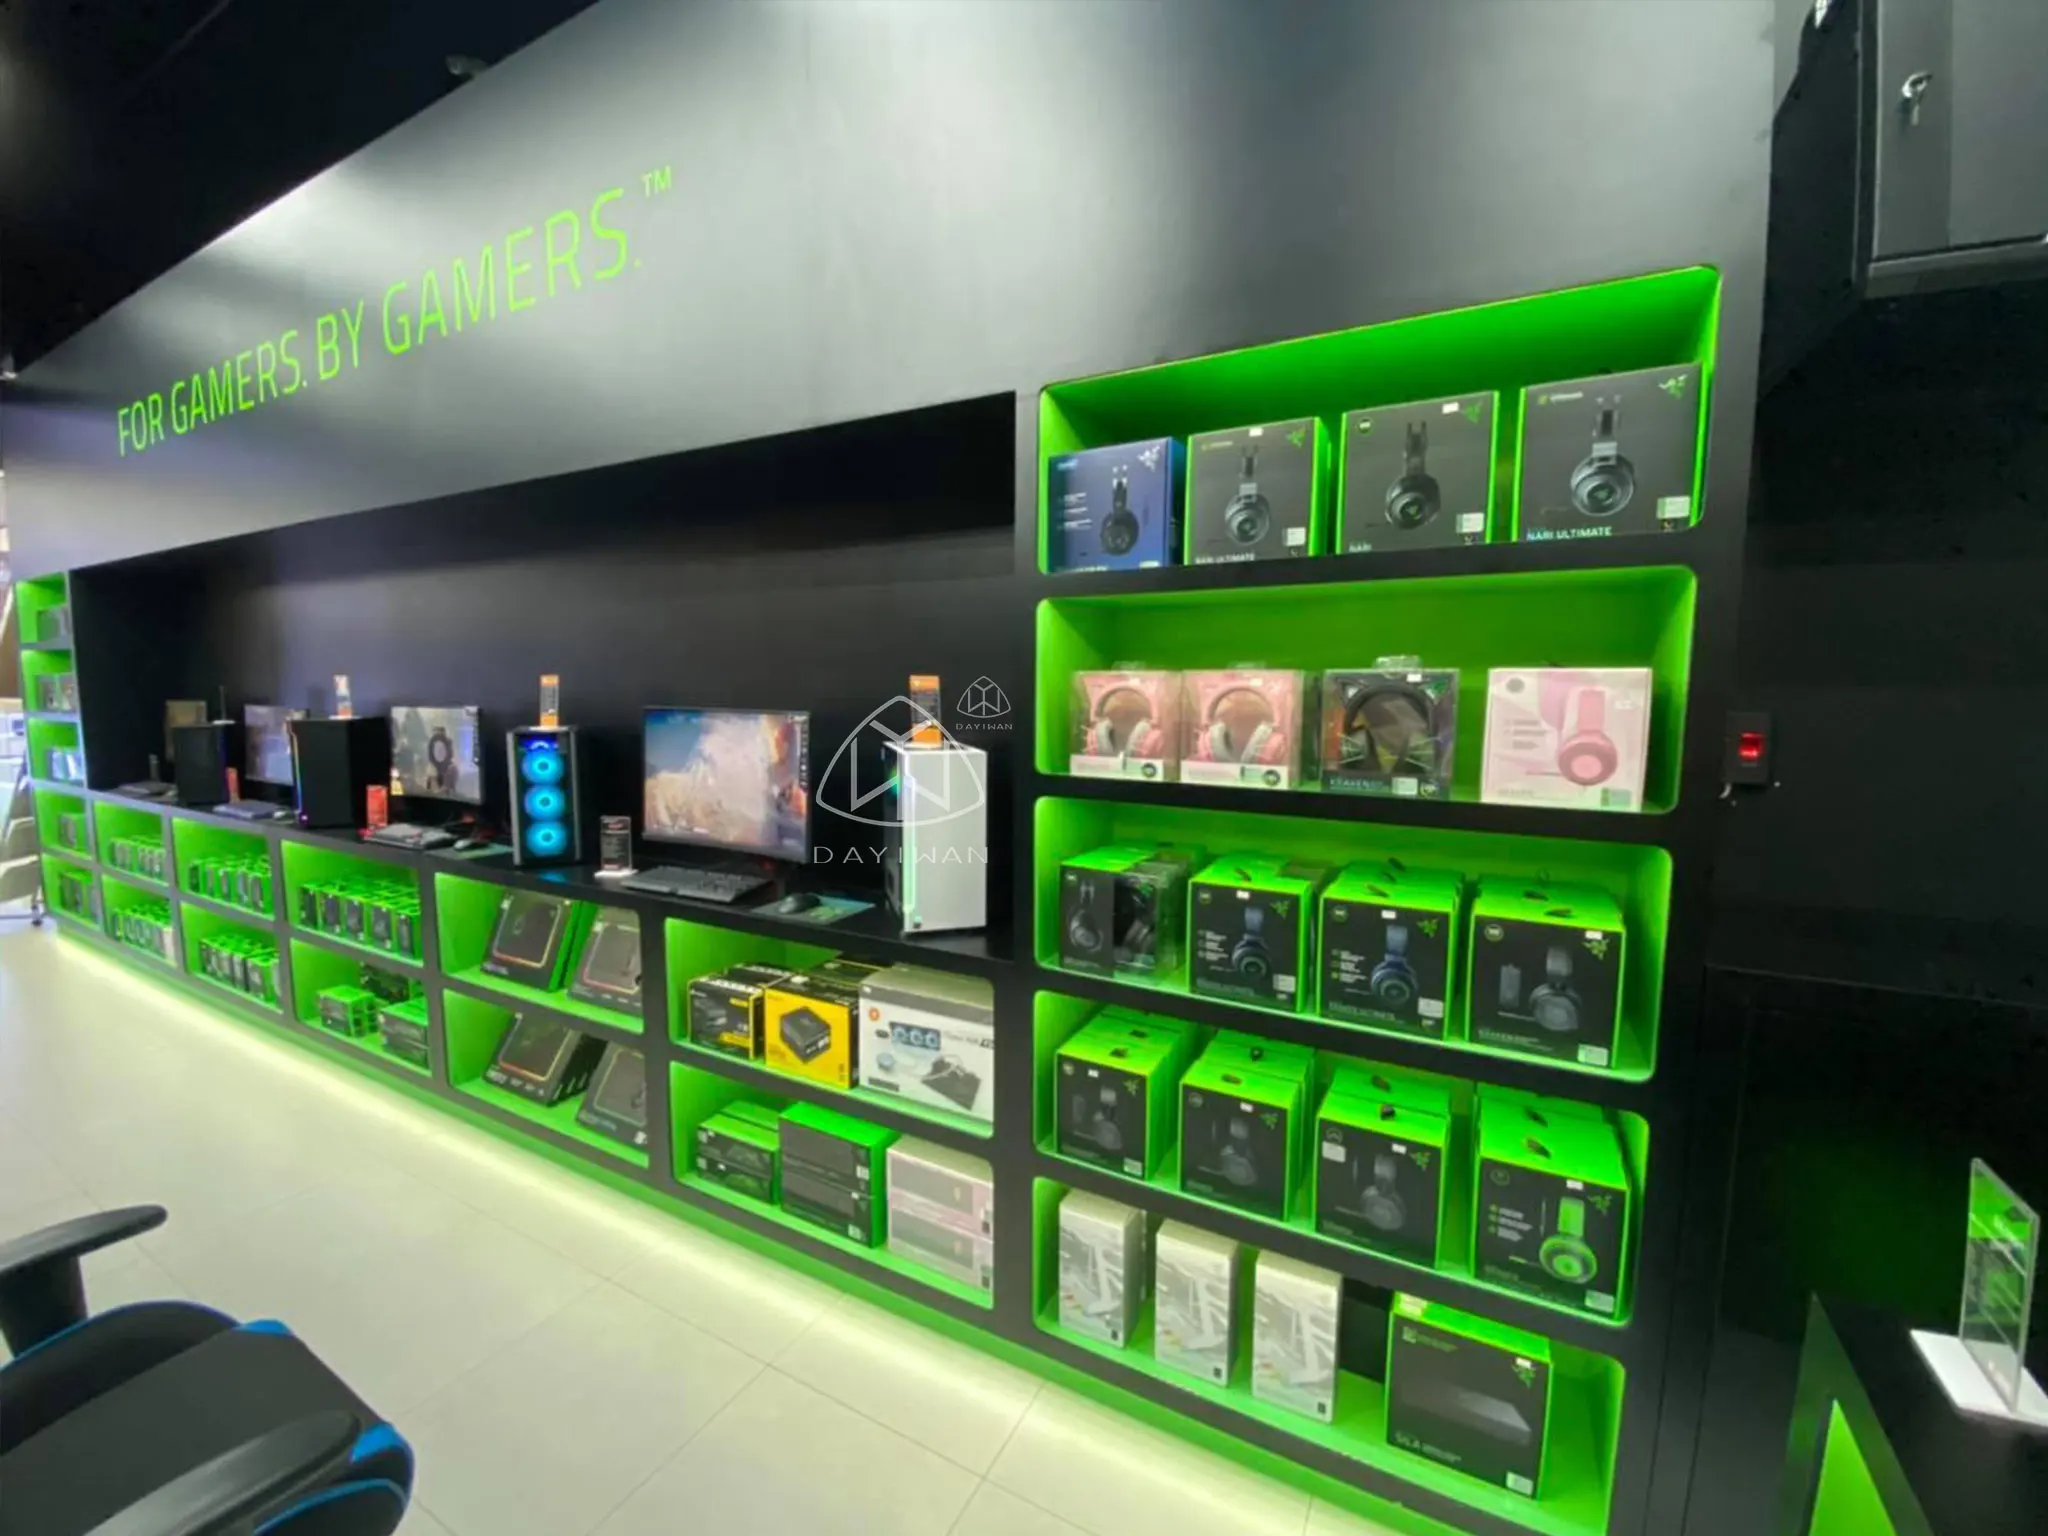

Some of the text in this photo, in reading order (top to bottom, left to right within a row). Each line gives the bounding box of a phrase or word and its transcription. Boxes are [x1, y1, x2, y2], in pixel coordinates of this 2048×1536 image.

[118, 392, 164, 456] FOR
[170, 329, 308, 435] GAMERS.
[316, 300, 365, 381] BY
[382, 187, 641, 354] GAMERS.
[1556, 526, 1612, 539] ULTIMATE
